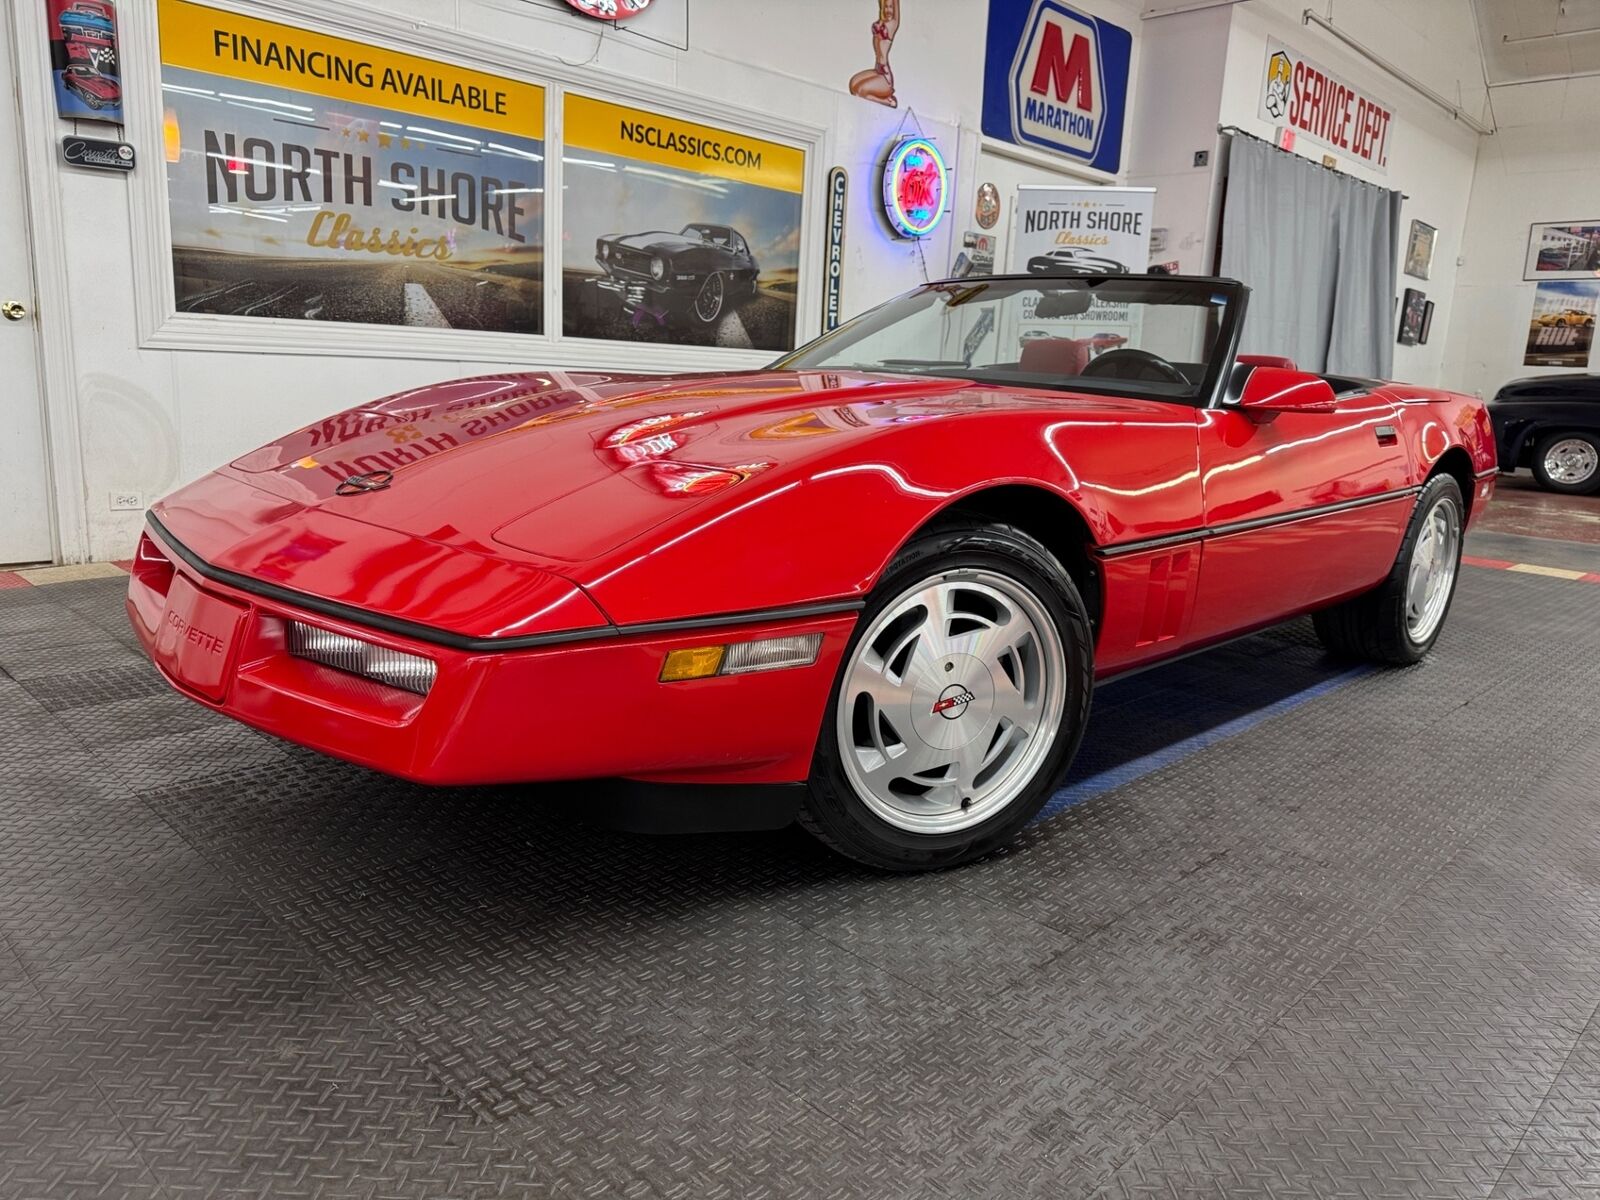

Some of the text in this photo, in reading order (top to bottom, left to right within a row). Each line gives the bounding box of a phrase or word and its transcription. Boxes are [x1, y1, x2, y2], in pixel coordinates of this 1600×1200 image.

[214, 29, 507, 115] FINANCING AVAILABLE
[1030, 21, 1092, 112] M
[1024, 97, 1094, 140] MARATHON
[1289, 60, 1391, 167] SERVICE DEPT.
[620, 120, 761, 170] NSCLASSICS.COM
[204, 129, 526, 243] NORTH SHORE
[306, 210, 454, 261] Classics
[1024, 210, 1143, 236] NORTH SHORE
[1054, 231, 1110, 247] Classics
[828, 177, 845, 327] CHEVROLET
[1535, 326, 1579, 346] RIDE
[168, 609, 225, 656] CORVETTE
